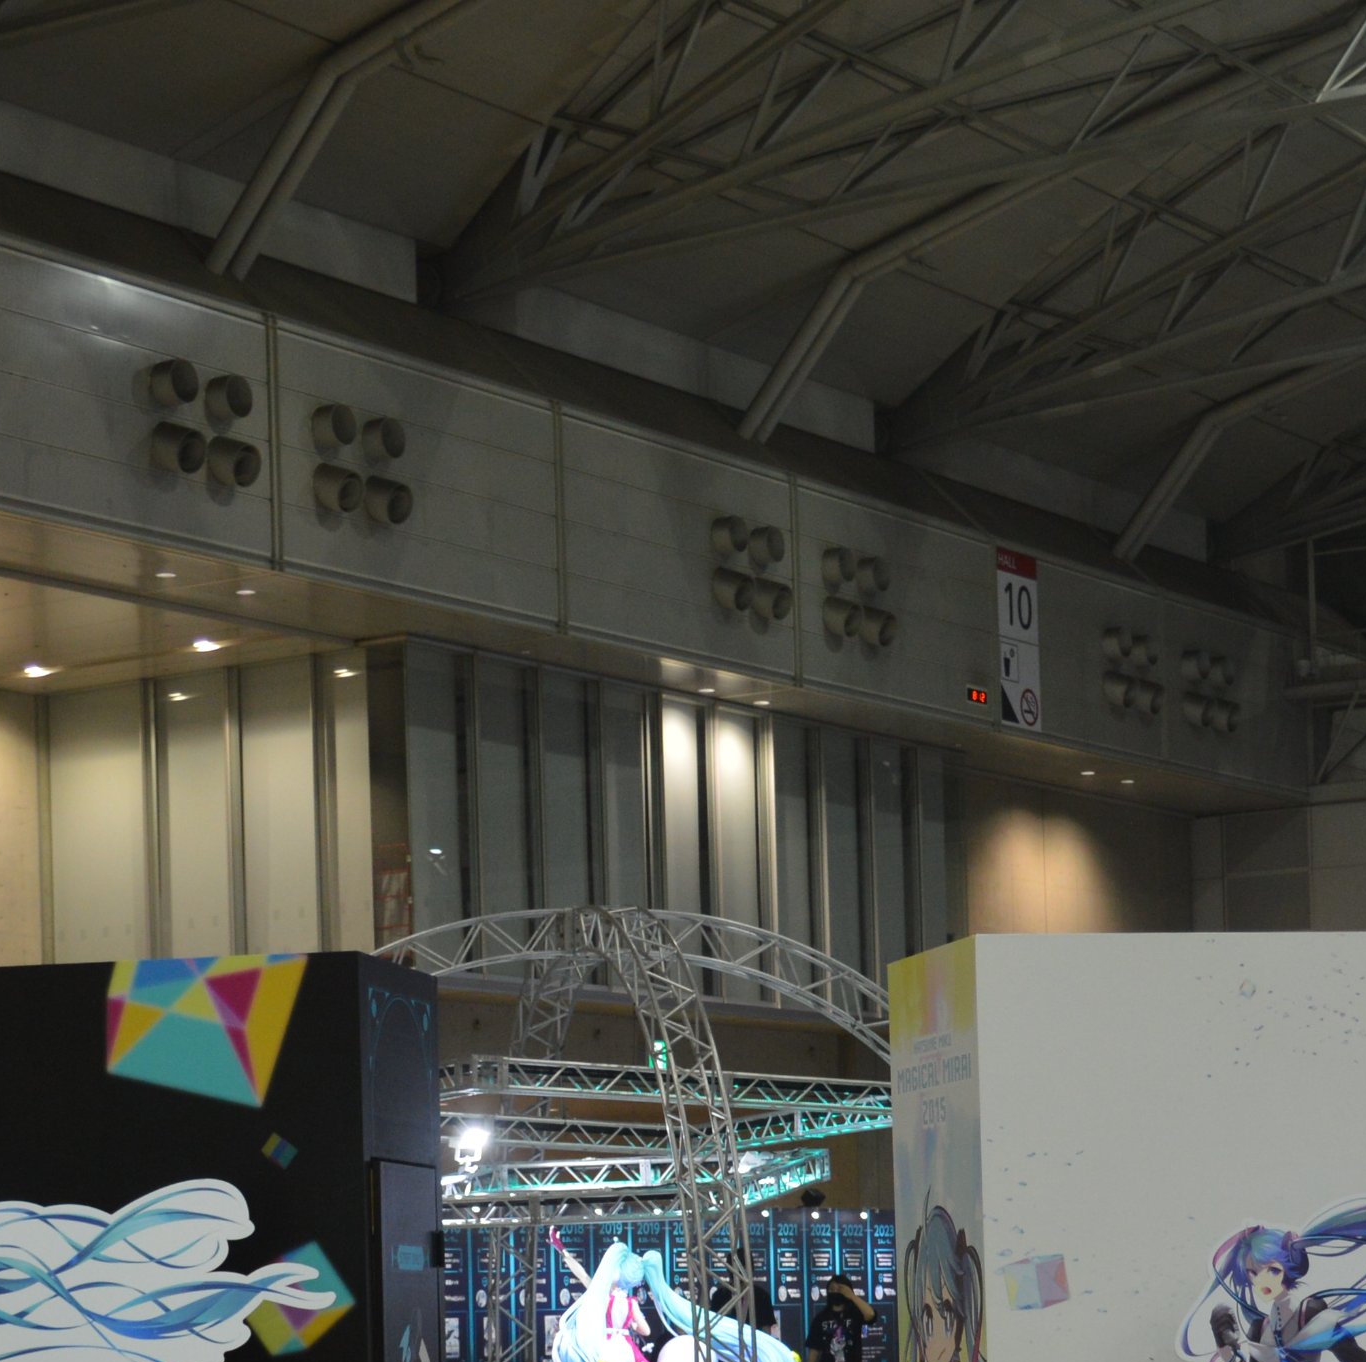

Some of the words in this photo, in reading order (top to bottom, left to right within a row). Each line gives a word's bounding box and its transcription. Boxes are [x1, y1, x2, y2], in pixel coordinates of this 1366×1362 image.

[996, 553, 1018, 570] HALL
[1004, 582, 1033, 631] 10
[897, 1062, 940, 1095] MAGICAL
[942, 1052, 972, 1084] MIRAI
[922, 1096, 947, 1125] 2015
[599, 1223, 623, 1235] 2019
[637, 1222, 661, 1235] 2019
[749, 1223, 765, 1236] 021
[778, 1223, 798, 1237] 2021
[811, 1223, 832, 1237] 2022
[842, 1224, 864, 1238] 2022
[874, 1224, 895, 1238] 2023
[821, 1318, 852, 1331] STAF
